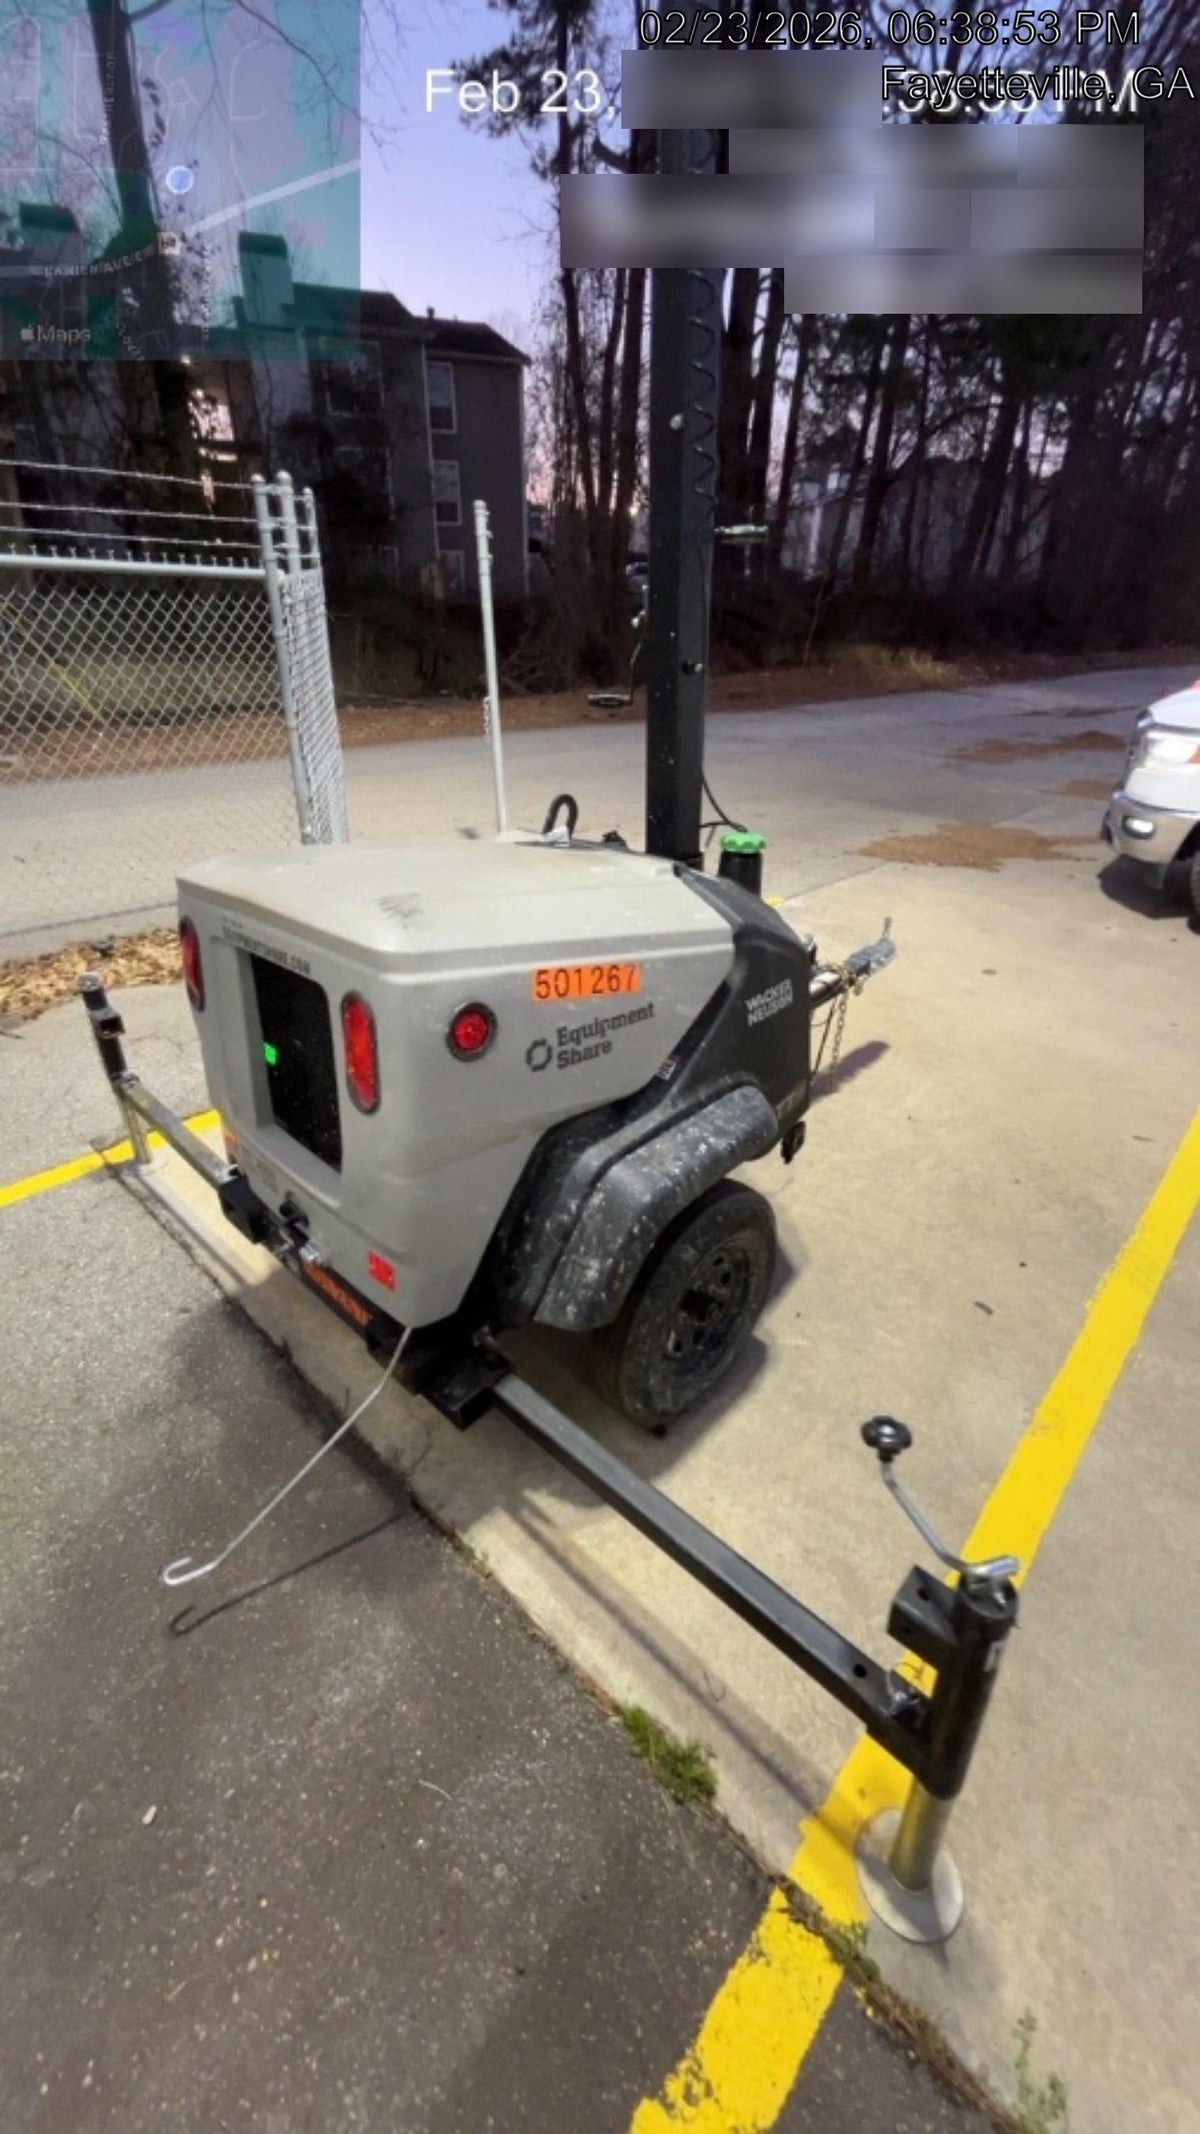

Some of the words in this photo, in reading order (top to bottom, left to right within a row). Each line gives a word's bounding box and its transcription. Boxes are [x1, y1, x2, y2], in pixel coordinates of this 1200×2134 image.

[535, 964, 636, 999] 501267
[556, 1002, 655, 1047] Equipment
[556, 1040, 613, 1070] Share
